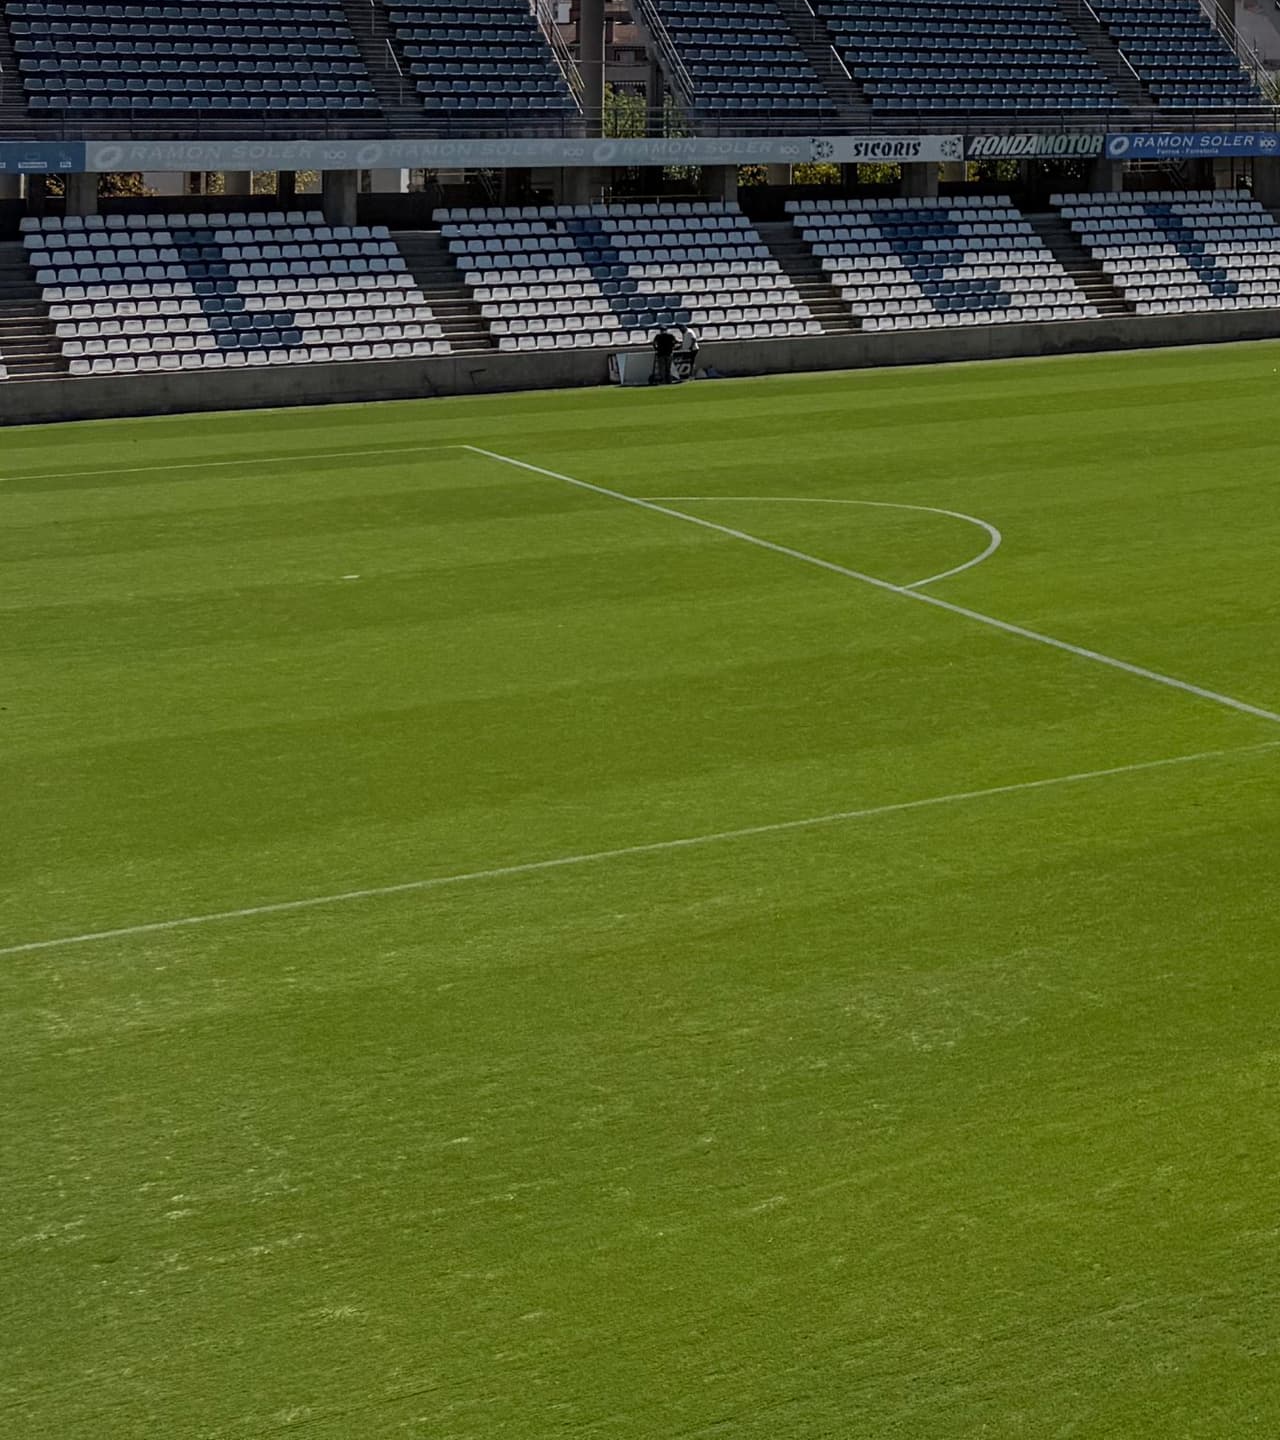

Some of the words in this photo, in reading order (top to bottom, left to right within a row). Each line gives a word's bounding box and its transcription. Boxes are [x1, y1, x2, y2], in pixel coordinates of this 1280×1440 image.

[622, 141, 697, 154] RAMON
[706, 140, 772, 152] SOLER
[968, 135, 1104, 154] RONDAMOTOR
[1133, 136, 1193, 147] RAMON
[1200, 135, 1254, 146] SOLER
[129, 146, 222, 160] RAMON
[232, 145, 314, 160] SOLER
[854, 142, 921, 157] SICORIS
